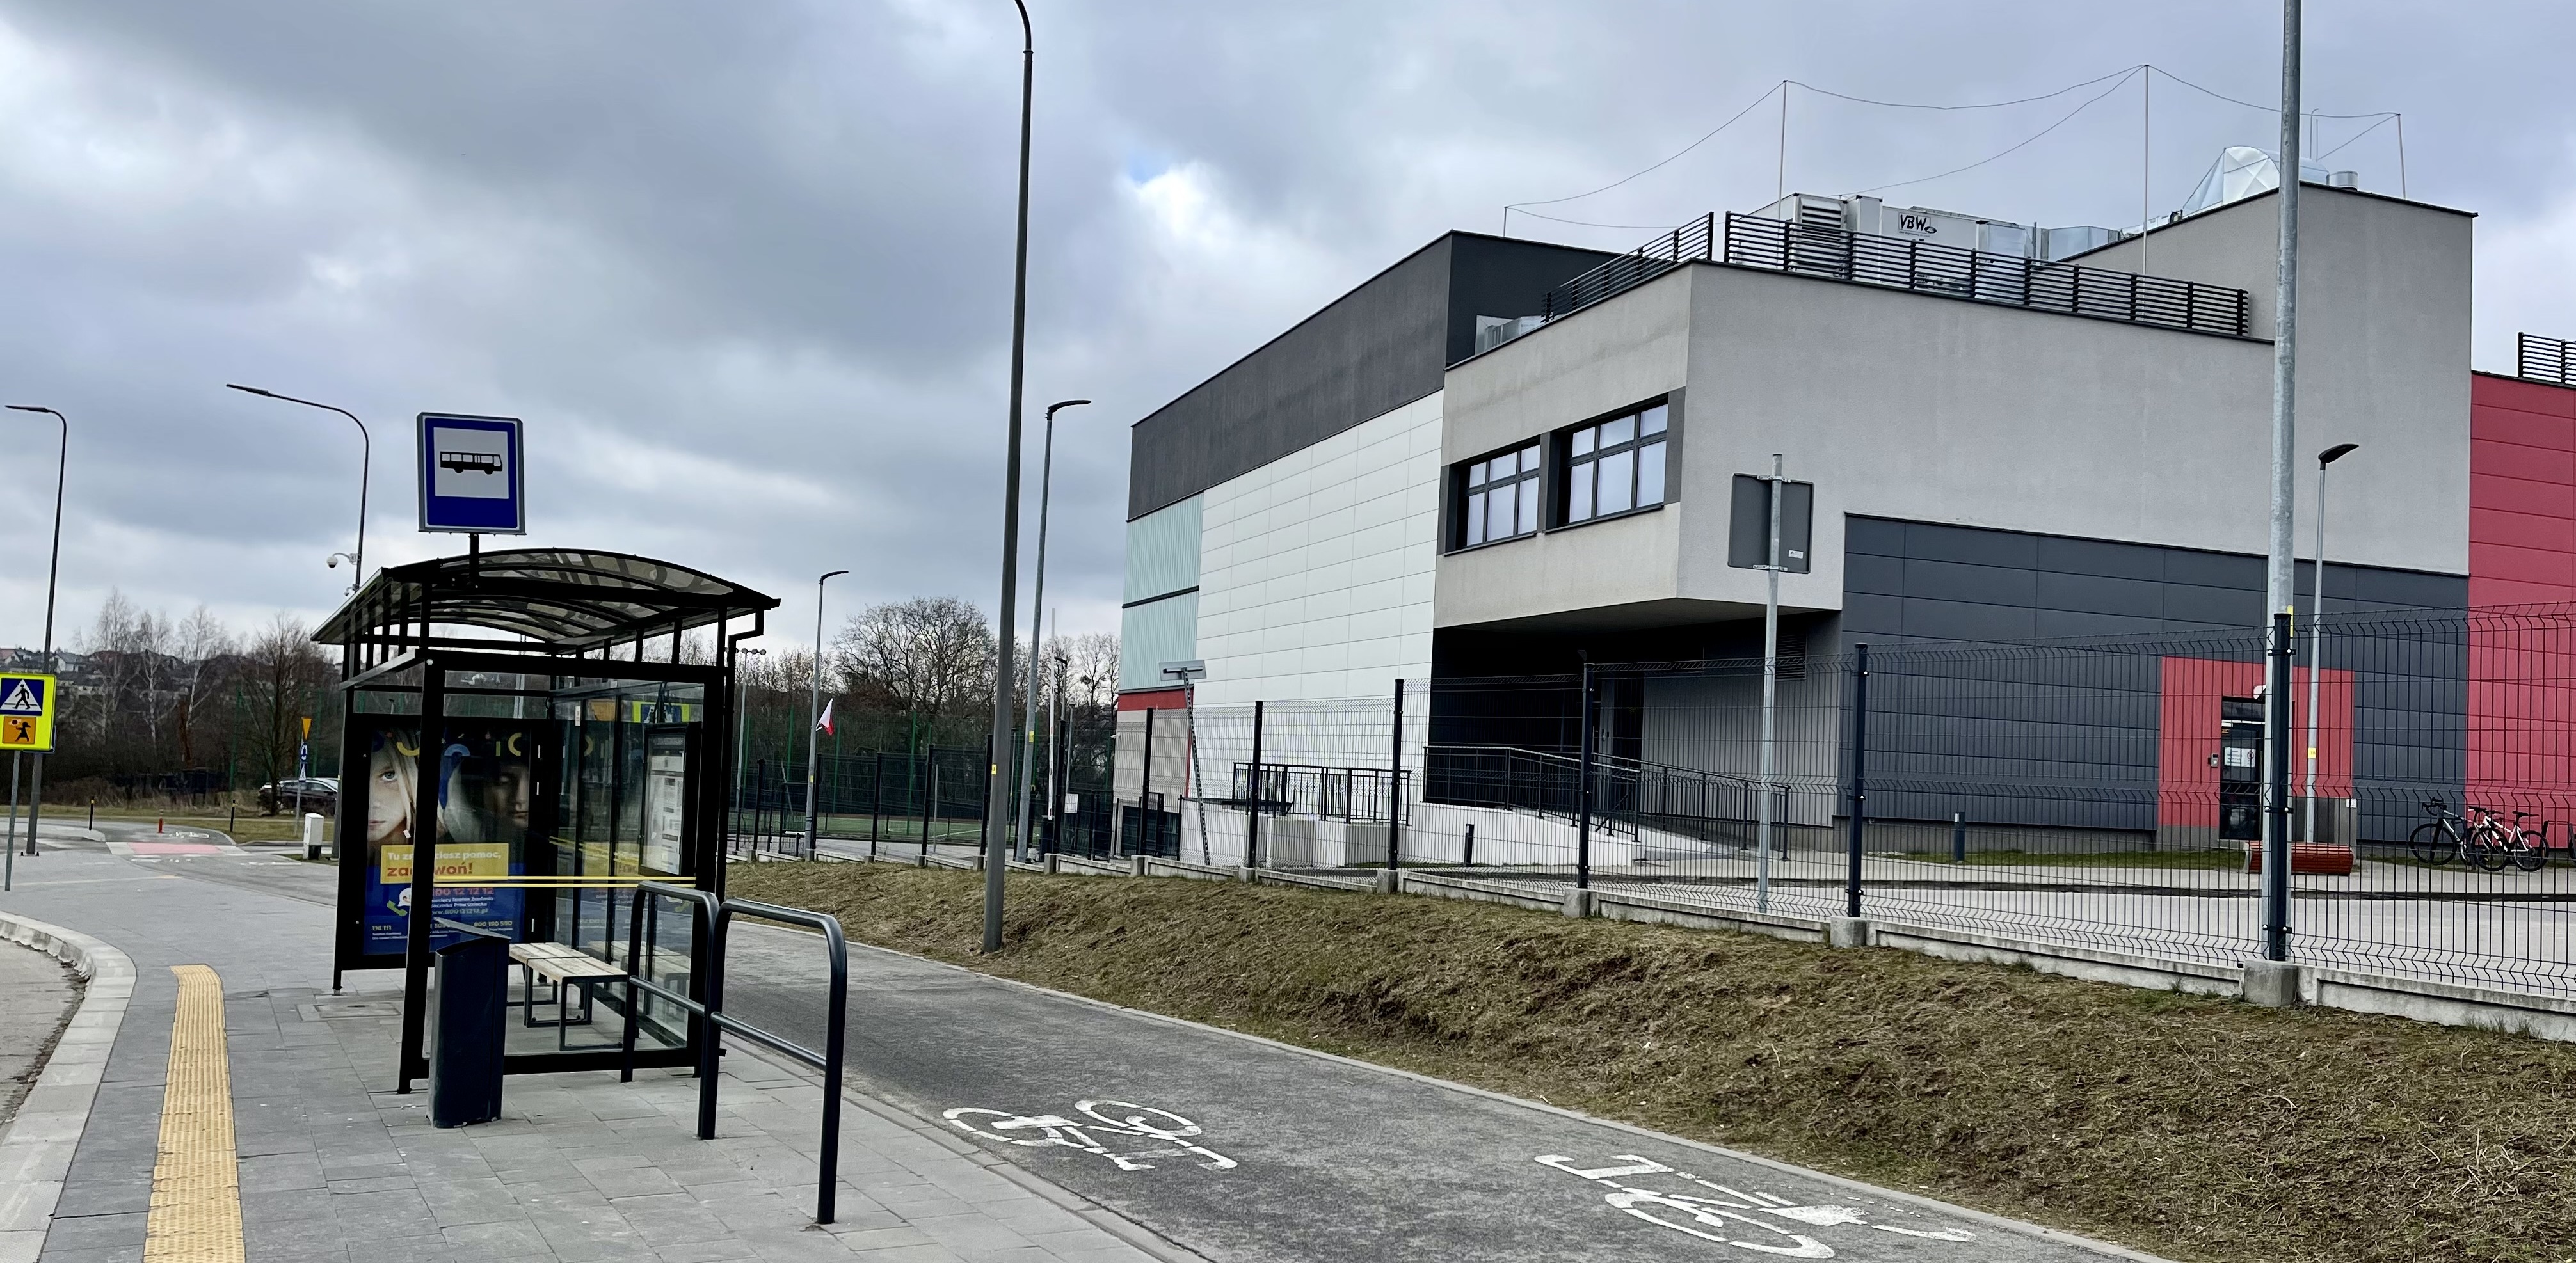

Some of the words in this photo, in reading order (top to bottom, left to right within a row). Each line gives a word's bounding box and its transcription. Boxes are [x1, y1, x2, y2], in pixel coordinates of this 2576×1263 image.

[1900, 214, 1927, 231] VBW
[463, 851, 501, 861] pomoc,
[387, 862, 473, 877] zawoń!
[433, 887, 451, 896] 00
